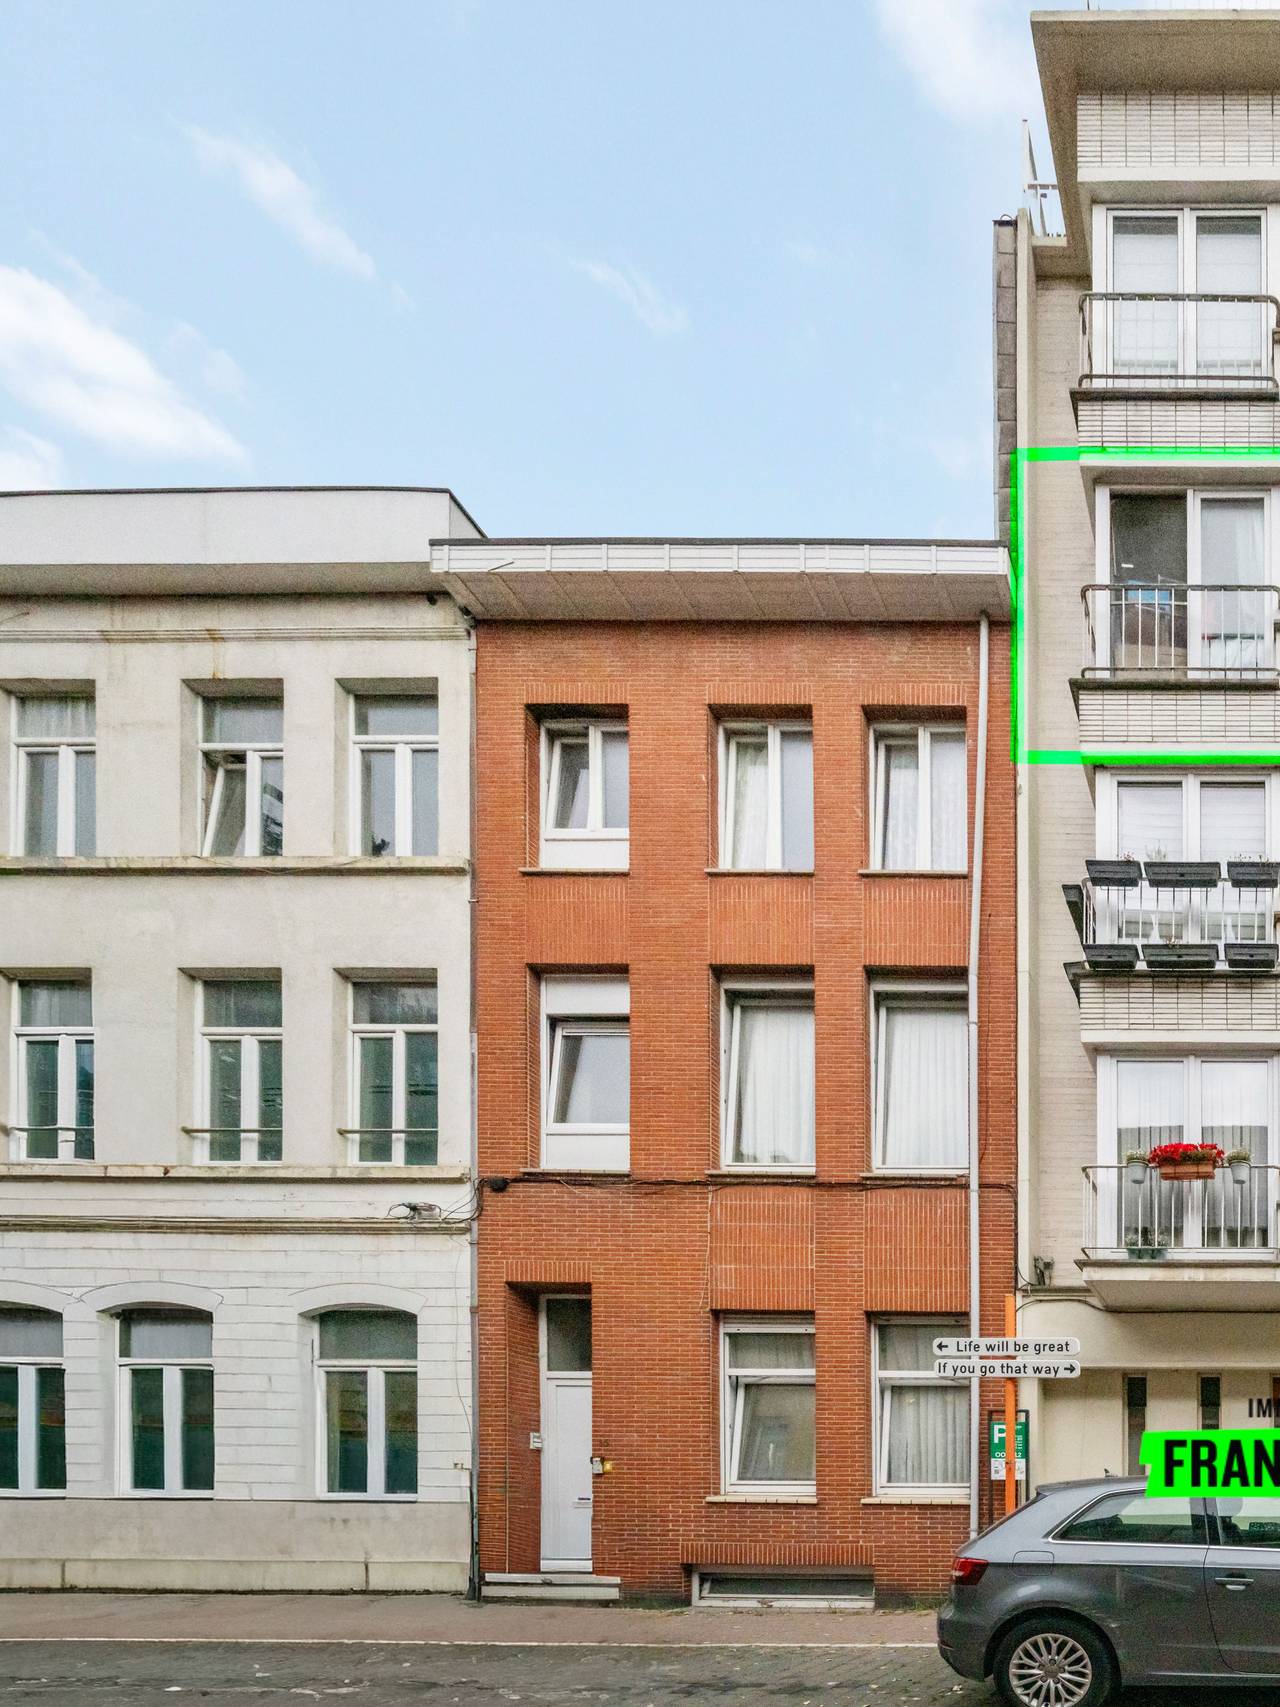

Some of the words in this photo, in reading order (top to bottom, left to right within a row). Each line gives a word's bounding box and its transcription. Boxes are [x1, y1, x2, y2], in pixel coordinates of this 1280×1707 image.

[956, 1340, 981, 1352] Life
[985, 1340, 1009, 1352] will
[1013, 1340, 1029, 1352] be
[1033, 1341, 1070, 1355] great
[938, 1362, 948, 1374] If
[952, 1364, 975, 1376] you
[980, 1365, 996, 1377] go
[1000, 1363, 1028, 1374] that
[1032, 1365, 1060, 1377] way
